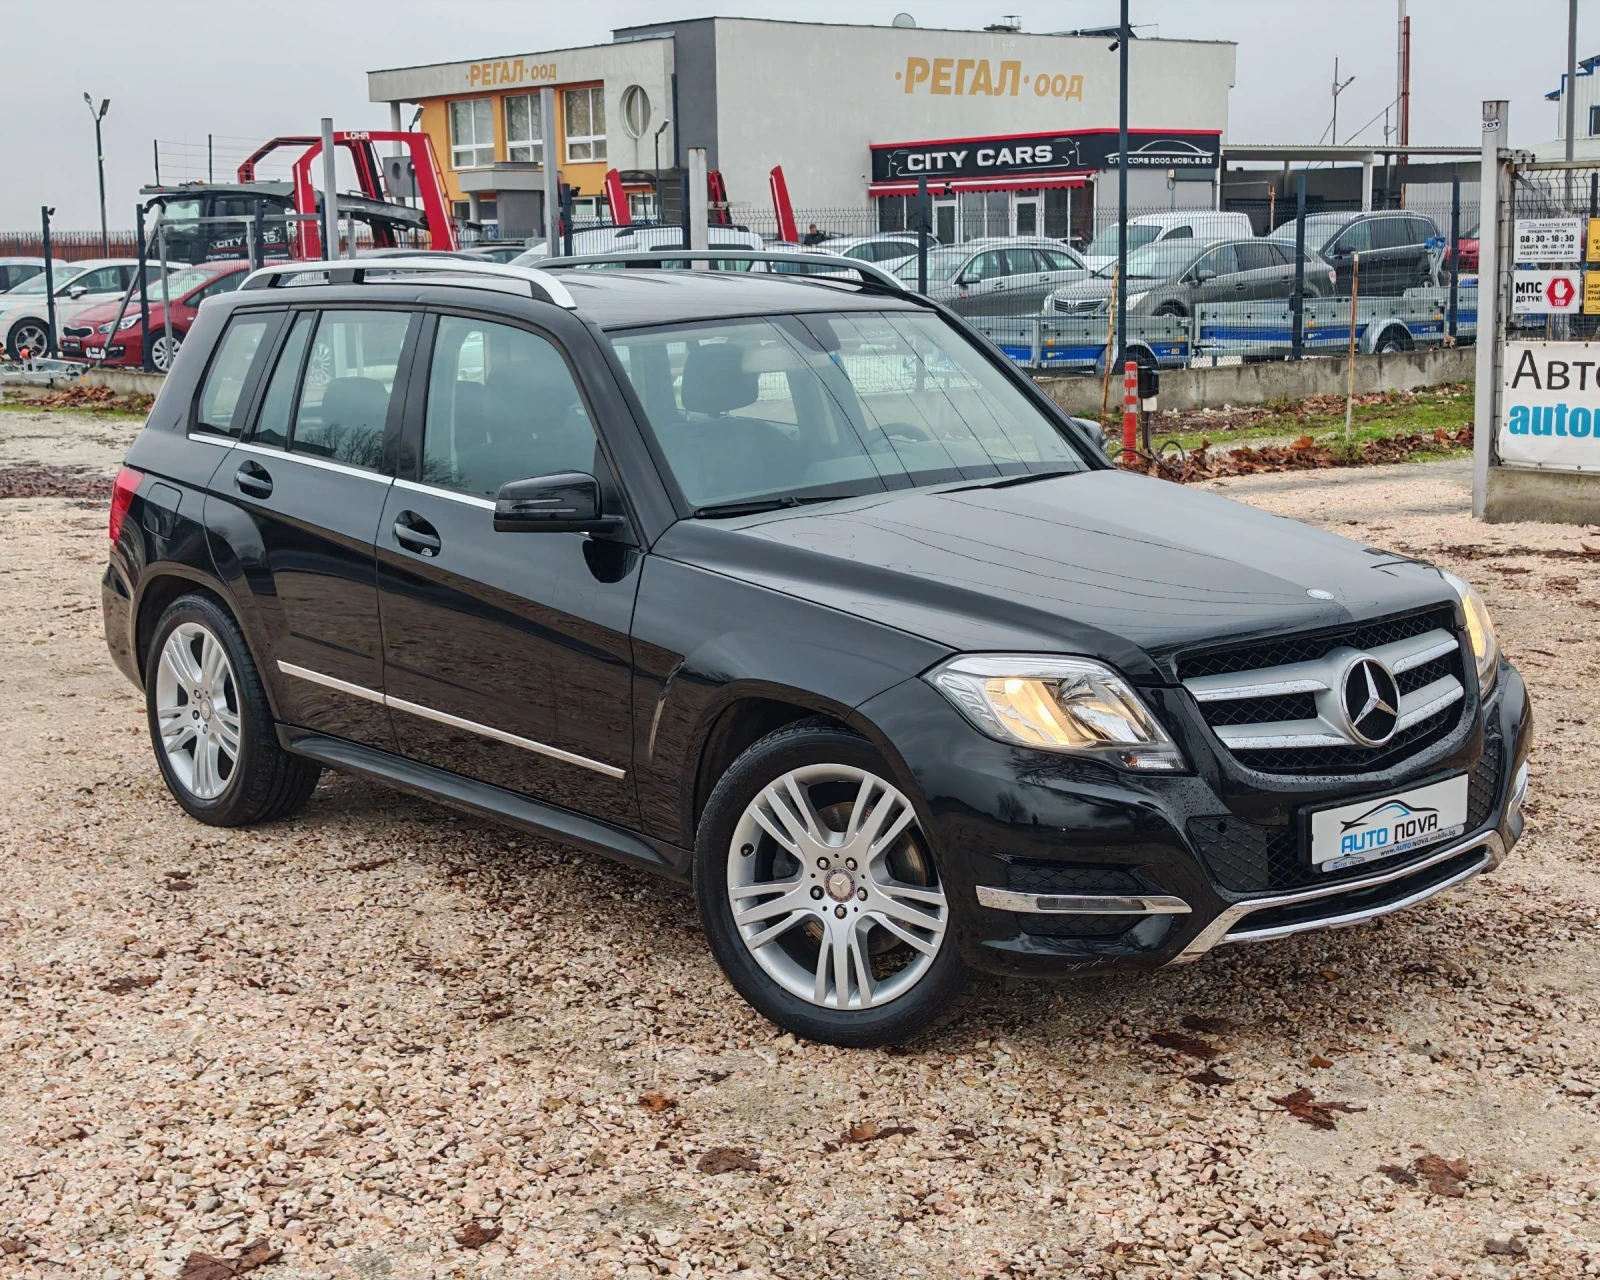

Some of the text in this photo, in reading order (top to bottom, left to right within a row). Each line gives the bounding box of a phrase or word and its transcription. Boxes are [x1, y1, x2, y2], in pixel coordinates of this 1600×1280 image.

[344, 132, 370, 140] LOHR
[907, 145, 1053, 171] CITY CARS
[216, 236, 243, 248] CITY
[1515, 281, 1543, 293] МПС
[1527, 295, 1543, 303] ТУК!
[1341, 827, 1388, 853] AUTO
